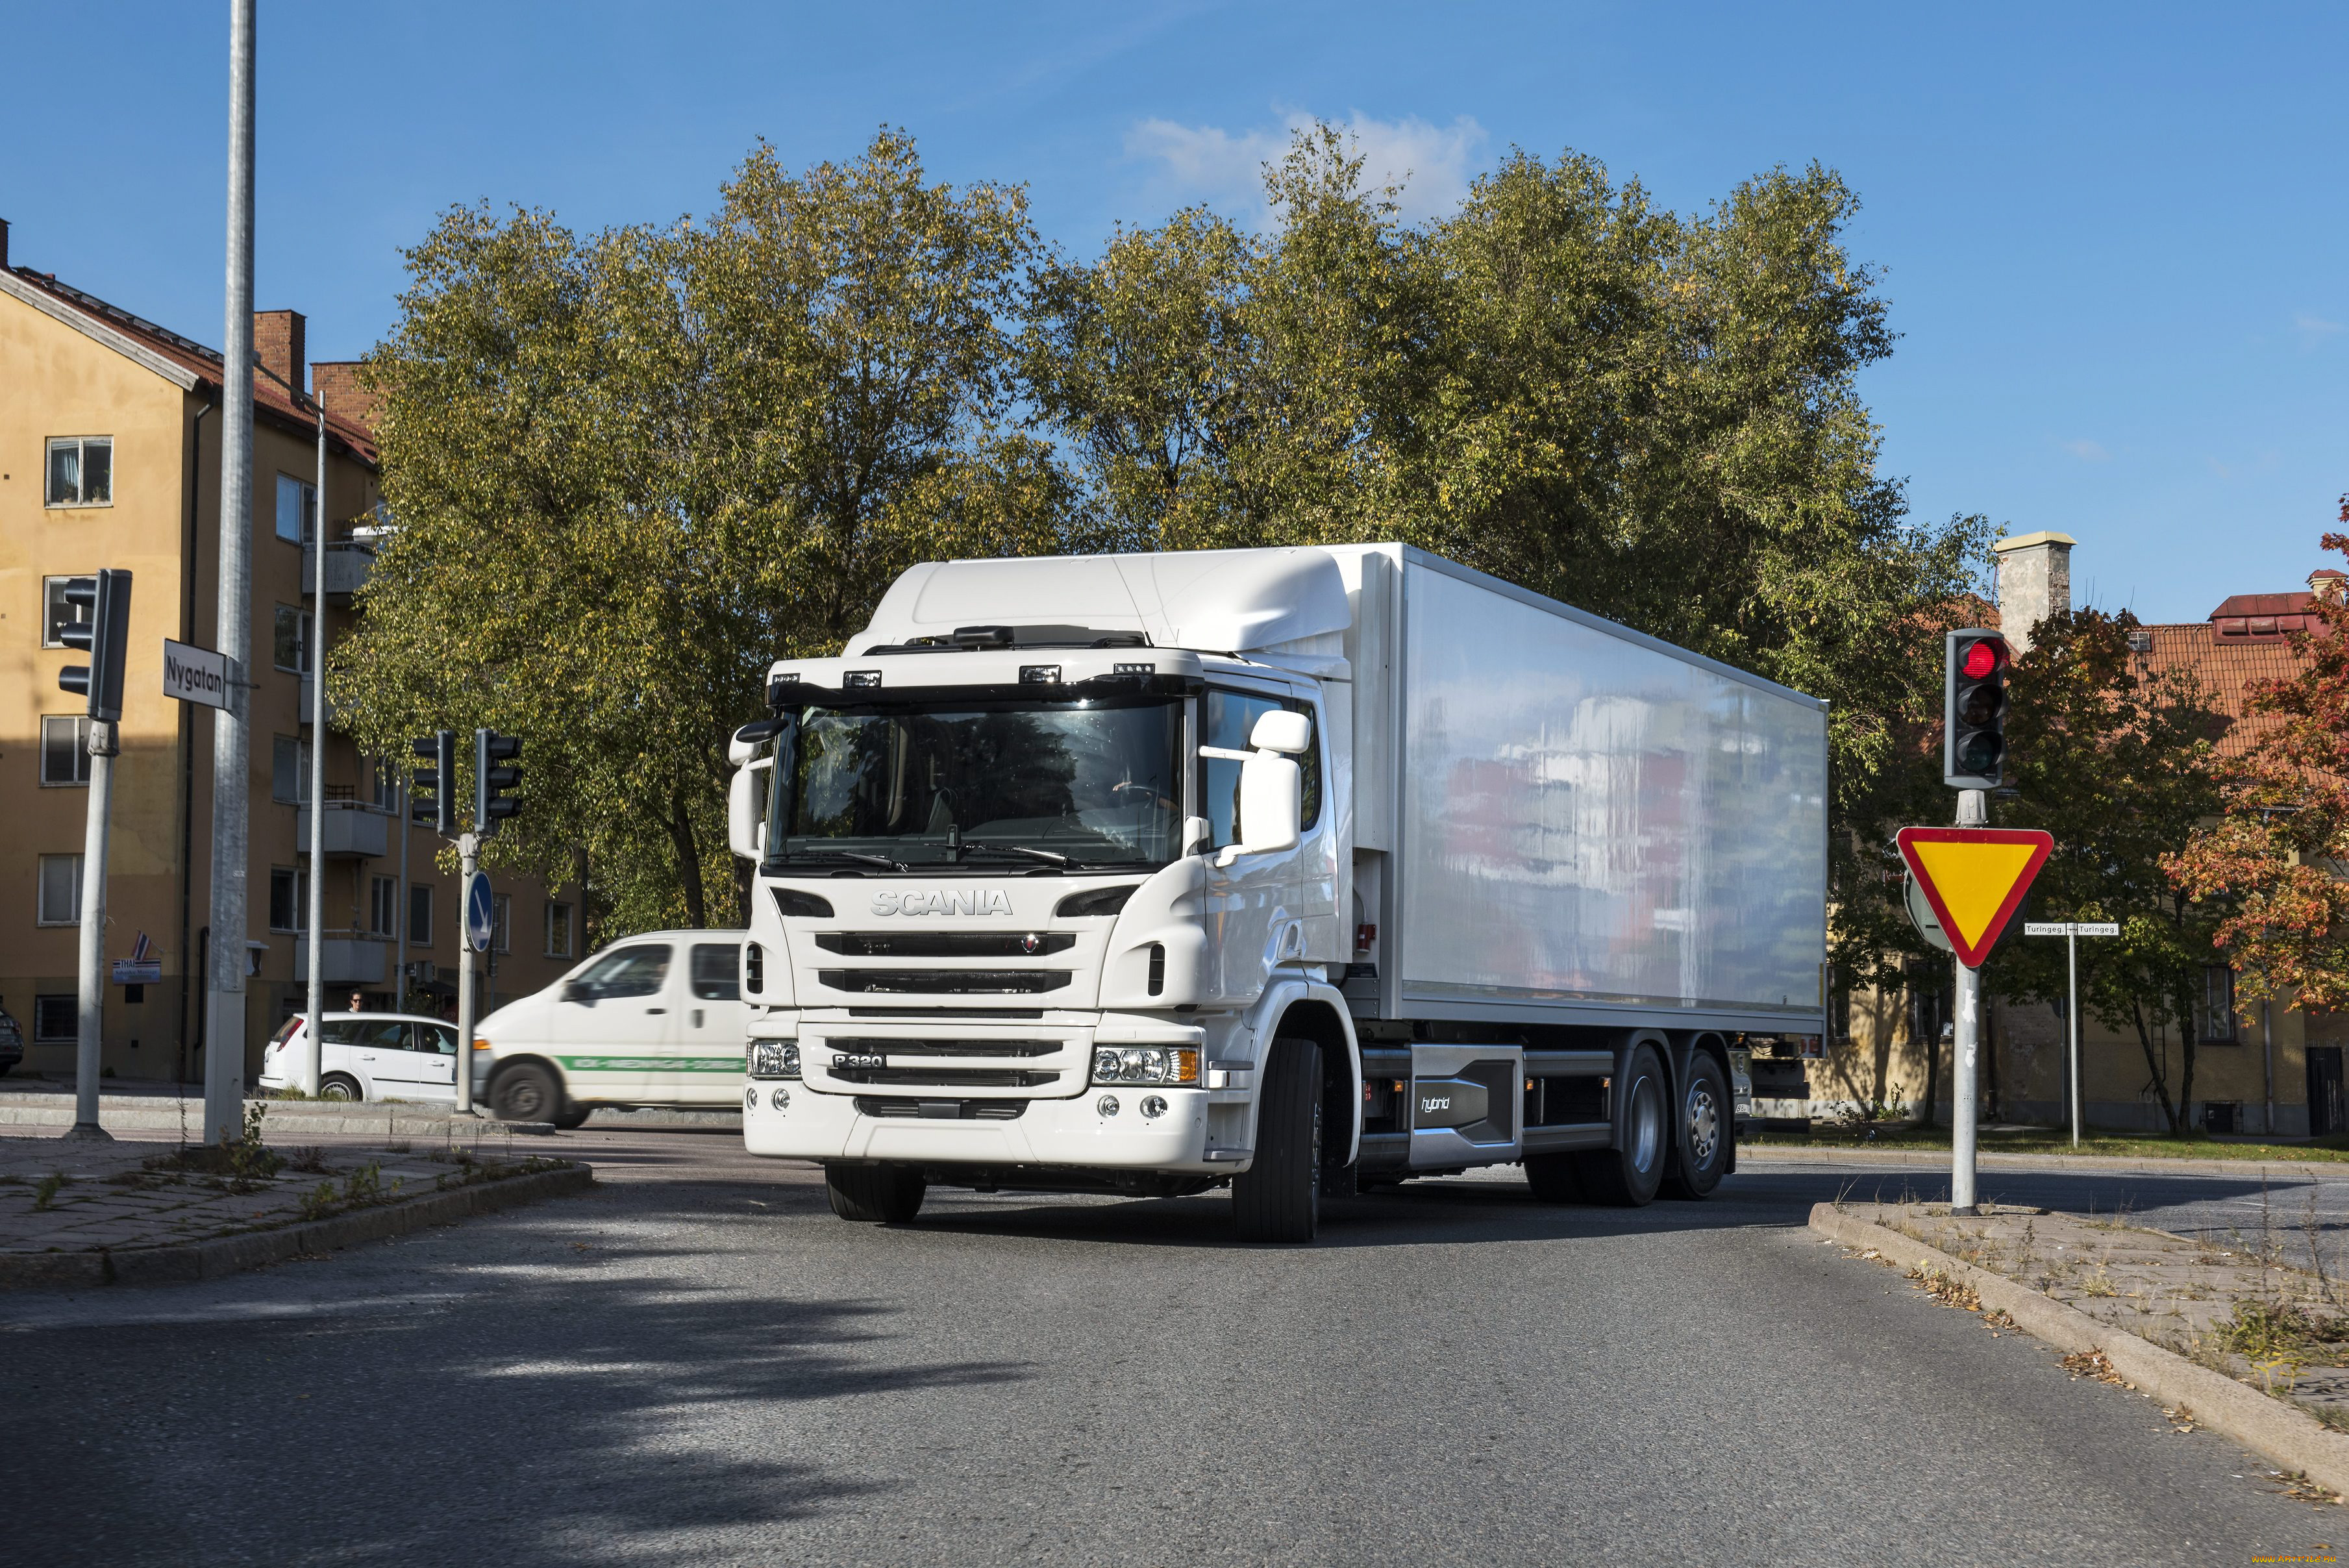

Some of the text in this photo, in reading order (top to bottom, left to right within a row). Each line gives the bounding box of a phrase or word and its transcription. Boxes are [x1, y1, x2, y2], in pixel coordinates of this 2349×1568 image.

[166, 654, 221, 694] Nygatan
[871, 889, 1013, 916] SCANIA
[2026, 925, 2065, 934] Turingeg.
[2079, 925, 2117, 934] Turingeg.
[120, 959, 136, 968] THAI
[835, 1055, 882, 1068] P 320
[1421, 1097, 1450, 1113] hybrid
